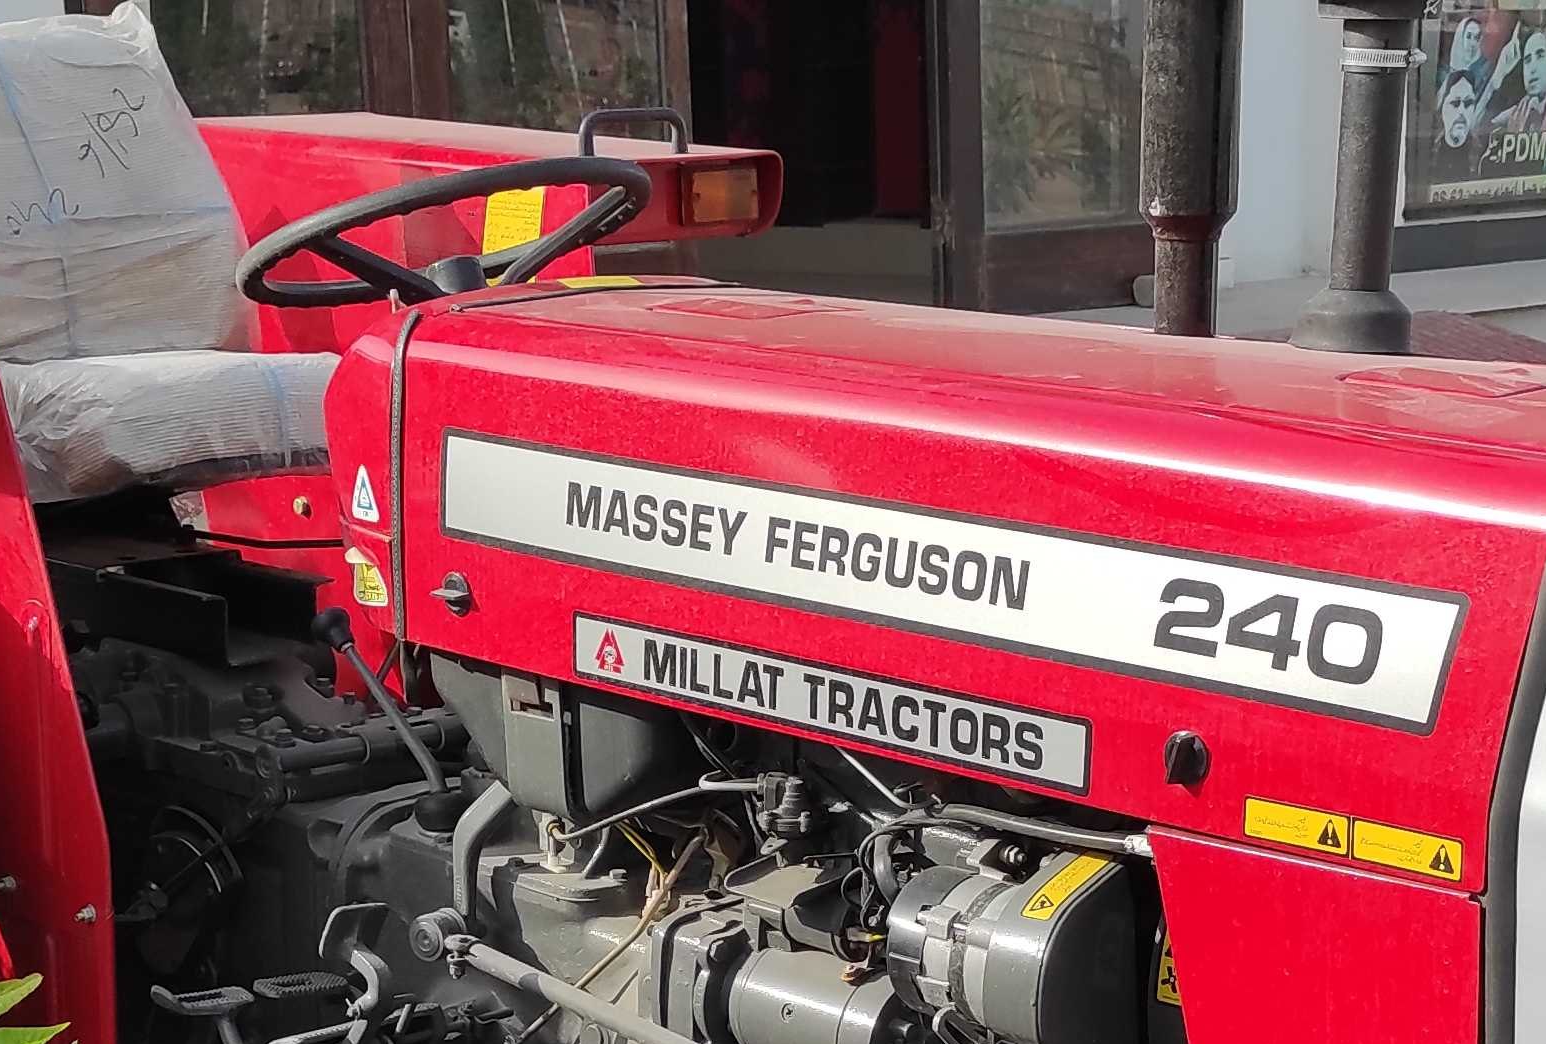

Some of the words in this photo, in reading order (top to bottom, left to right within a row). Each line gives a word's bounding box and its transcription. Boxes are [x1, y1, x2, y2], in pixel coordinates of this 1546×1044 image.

[1502, 132, 1546, 163] PDM
[565, 481, 748, 556] MASSEY
[764, 517, 1031, 611] FERGUSON
[1153, 577, 1383, 686] 240
[643, 637, 785, 711] MILLAT
[803, 672, 1045, 771] TRACTORS
